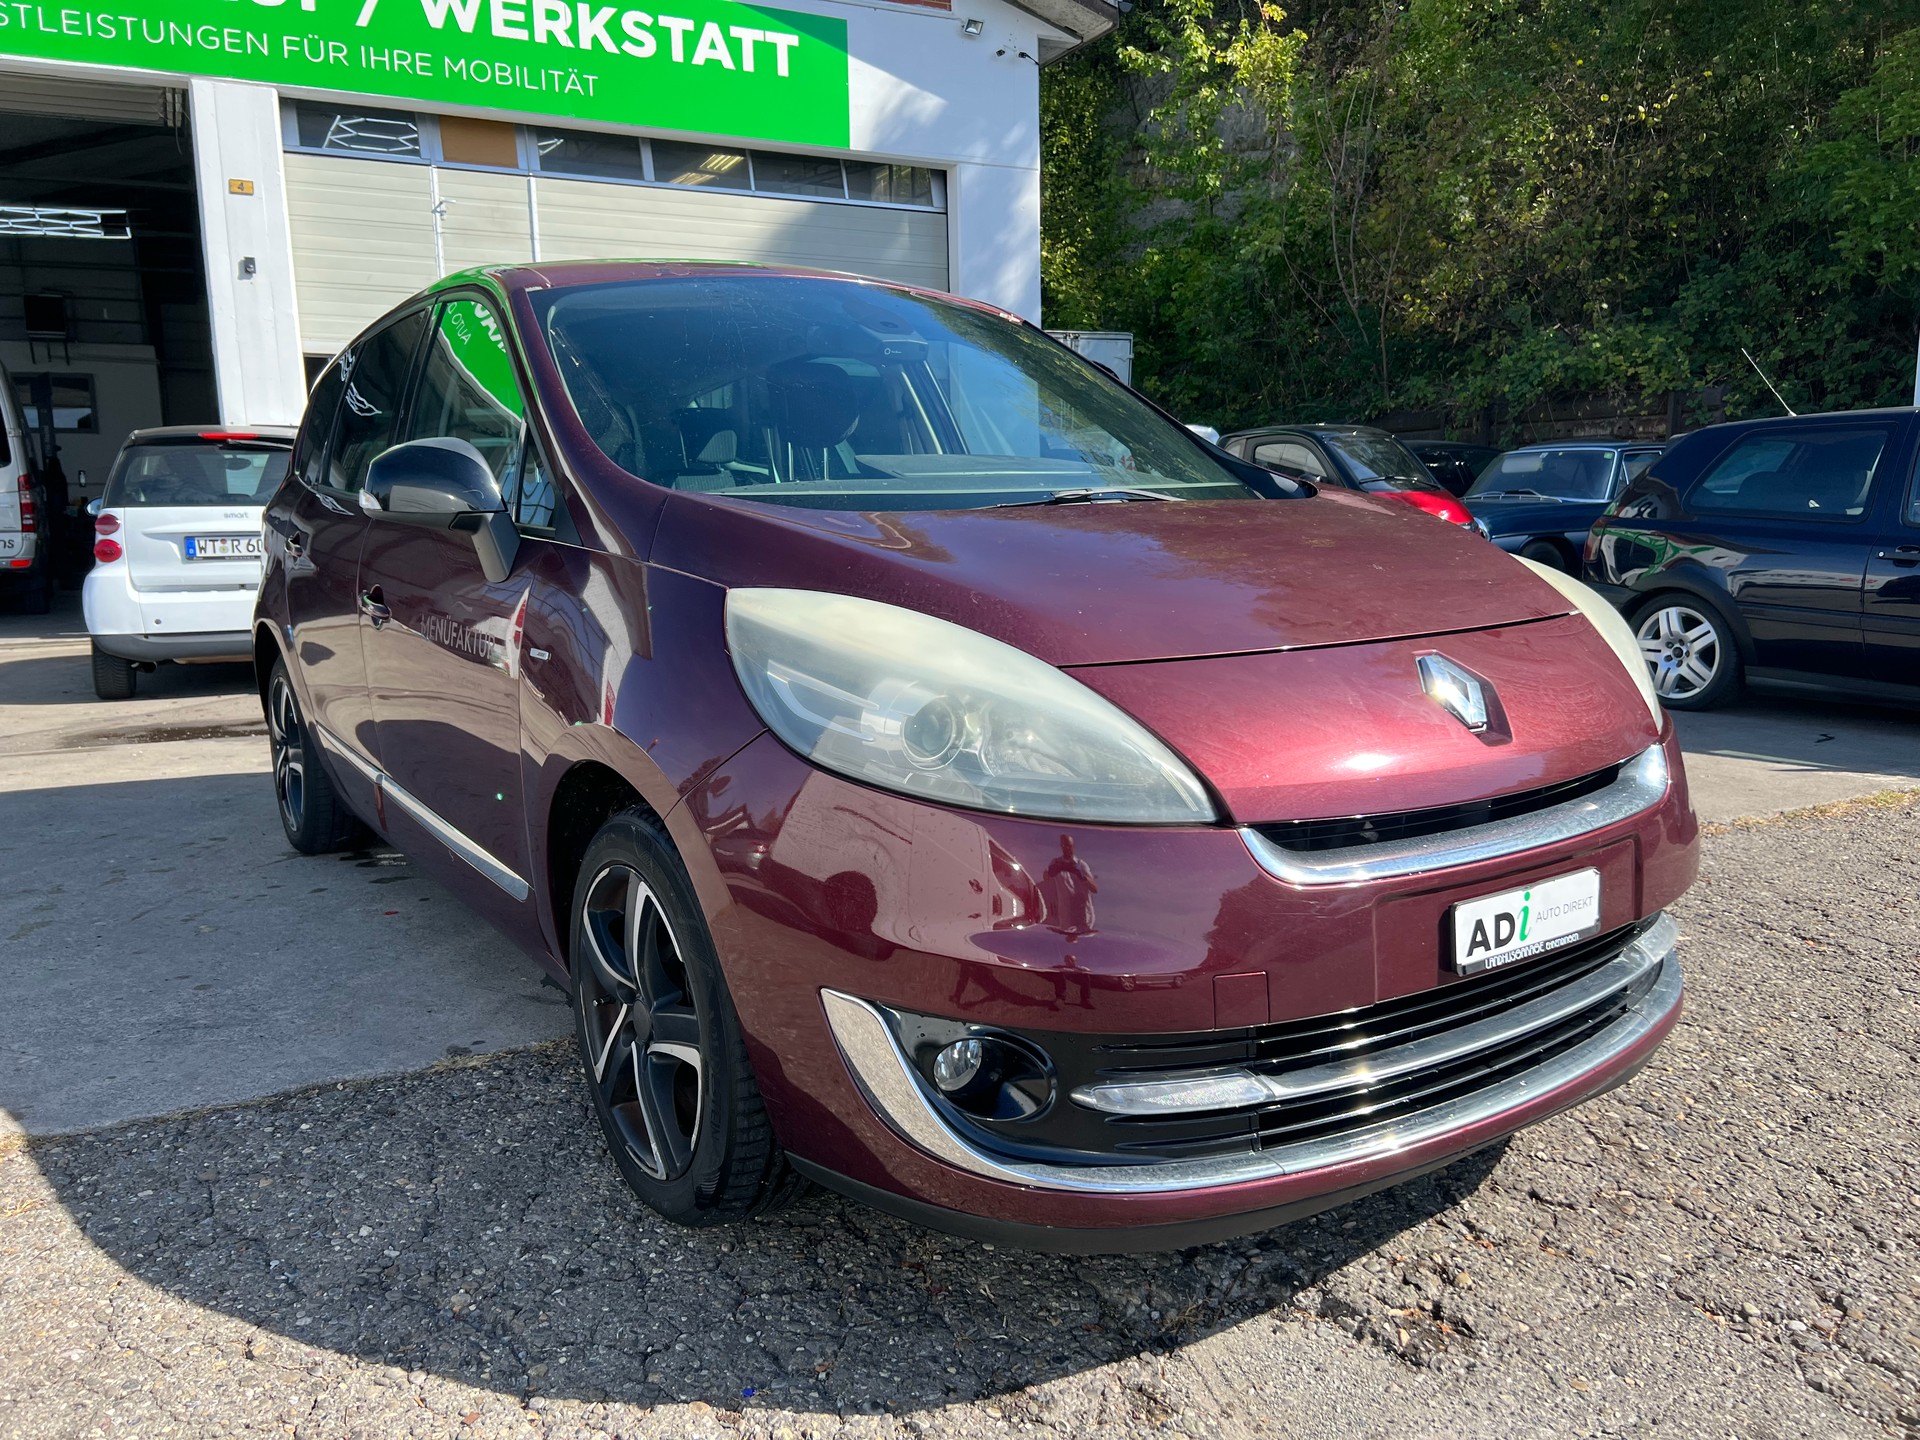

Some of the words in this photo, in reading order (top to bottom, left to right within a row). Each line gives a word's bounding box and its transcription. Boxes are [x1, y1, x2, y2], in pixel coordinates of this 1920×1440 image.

[419, 0, 799, 78] WERKSTATT
[283, 33, 349, 66] FÜR
[360, 45, 433, 76] IHRE
[444, 56, 598, 97] MOBILITÄT
[197, 539, 219, 554] WT
[231, 539, 242, 554] R
[1535, 905, 1561, 923] AUTO
[1563, 896, 1593, 914] DIREKT
